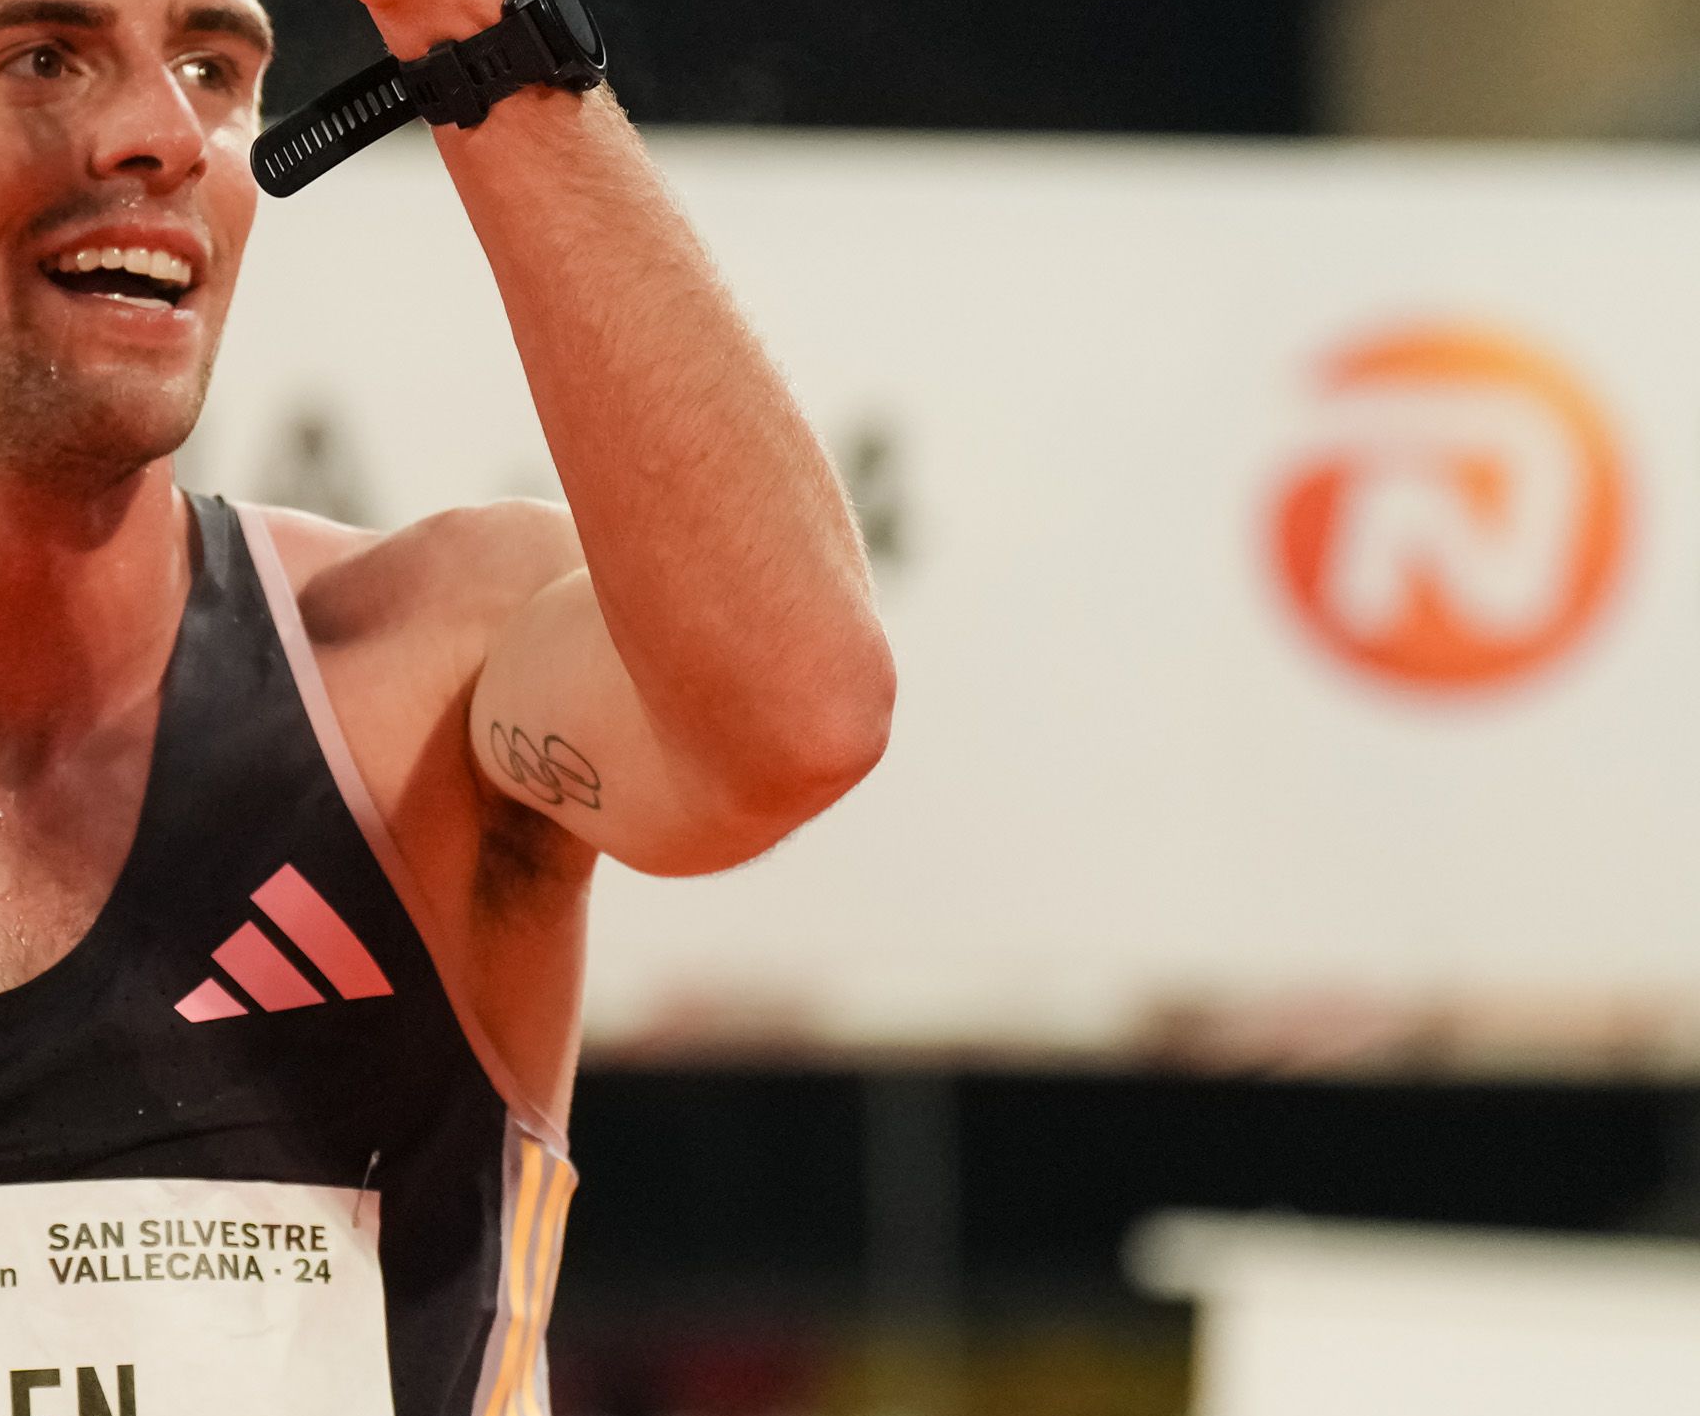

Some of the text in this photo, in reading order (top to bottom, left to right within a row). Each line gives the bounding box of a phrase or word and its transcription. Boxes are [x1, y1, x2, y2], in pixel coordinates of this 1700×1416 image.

[48, 1219, 329, 1253] SAN SILVESTRE
[48, 1252, 265, 1285] VALLECANA
[292, 1257, 332, 1285] 24
